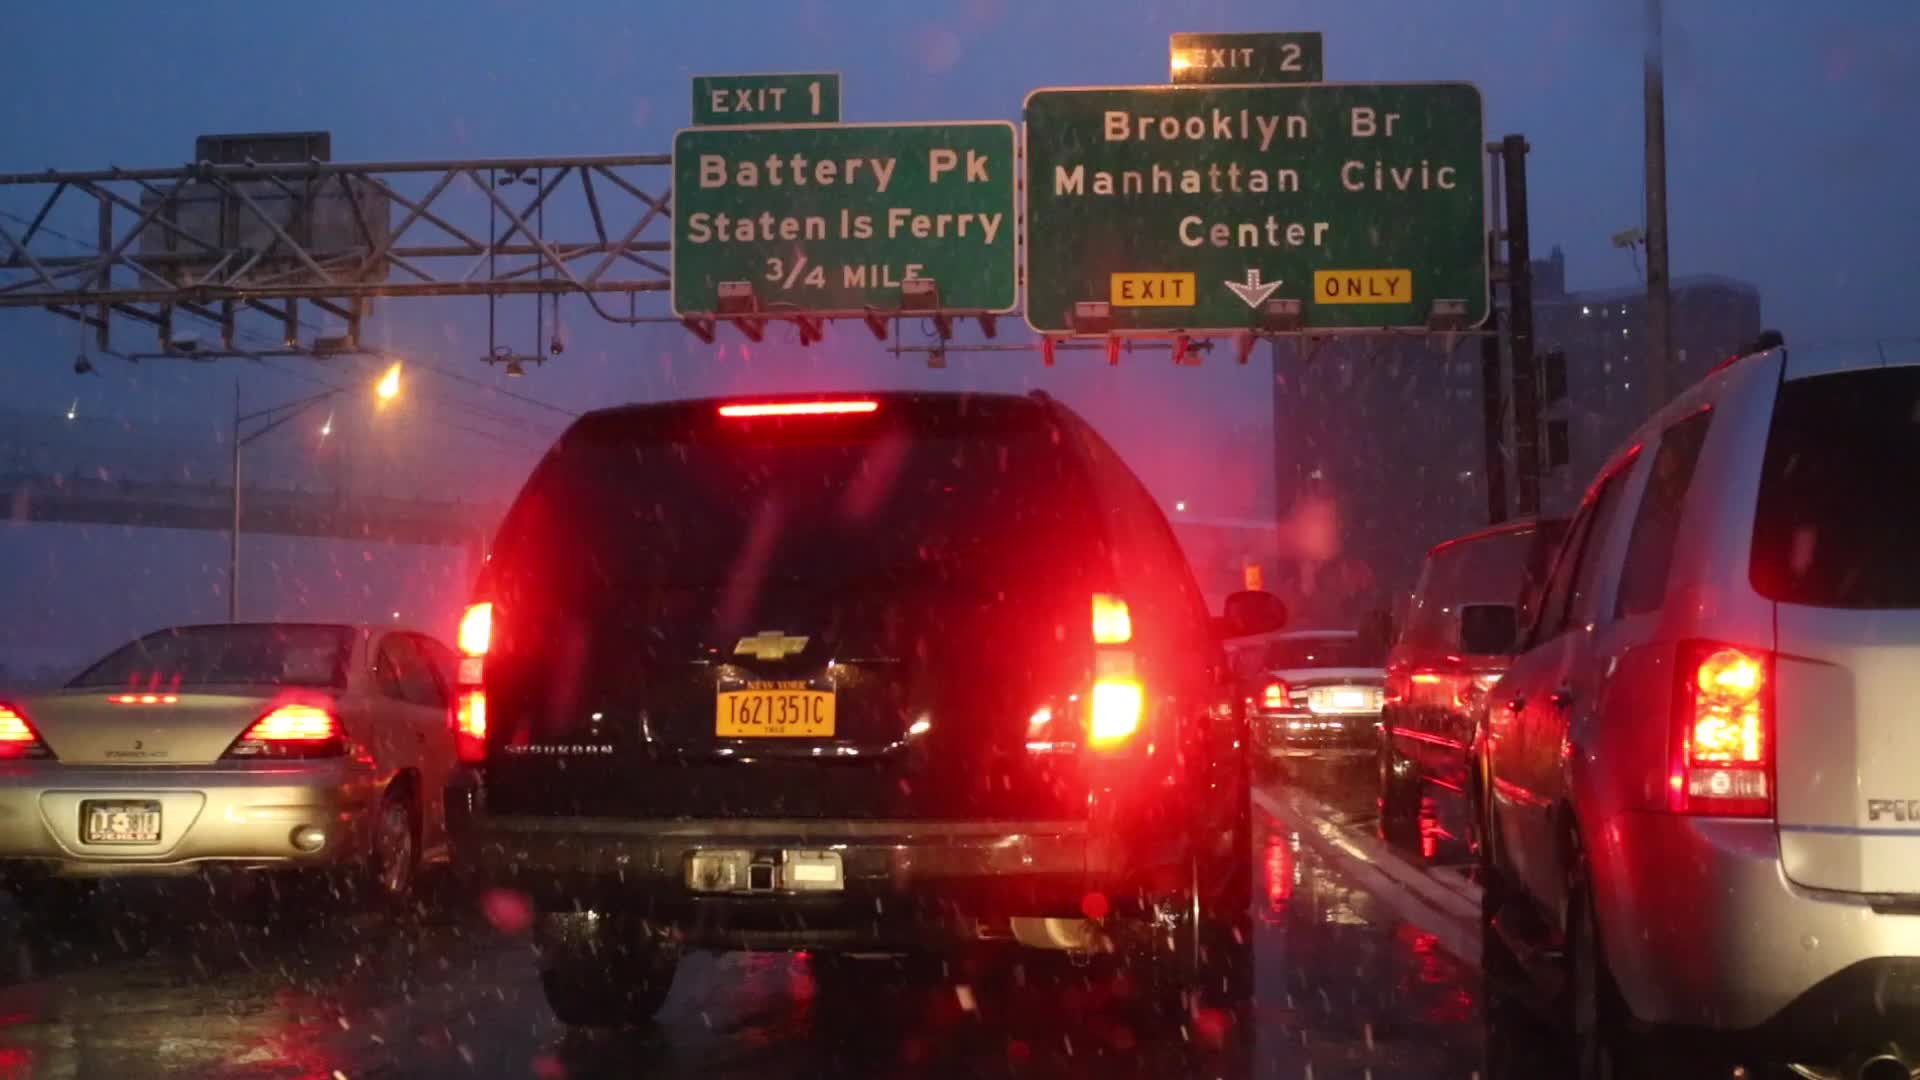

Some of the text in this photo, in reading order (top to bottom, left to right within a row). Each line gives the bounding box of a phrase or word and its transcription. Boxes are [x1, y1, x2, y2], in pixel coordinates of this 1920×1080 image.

[1192, 43, 1302, 71] EXIT 2
[711, 81, 822, 116] EXIT 1
[1104, 107, 1400, 151] Brooklyn Br
[699, 149, 990, 193] Battery Pk
[1055, 160, 1457, 196] Manhattan Civic
[687, 207, 1003, 245] Staten Is Ferry
[1178, 216, 1330, 248] Center
[765, 256, 924, 290] 3/4 MILE
[1121, 276, 1401, 300] EXIT ONLY
[728, 695, 824, 725] T621351C
